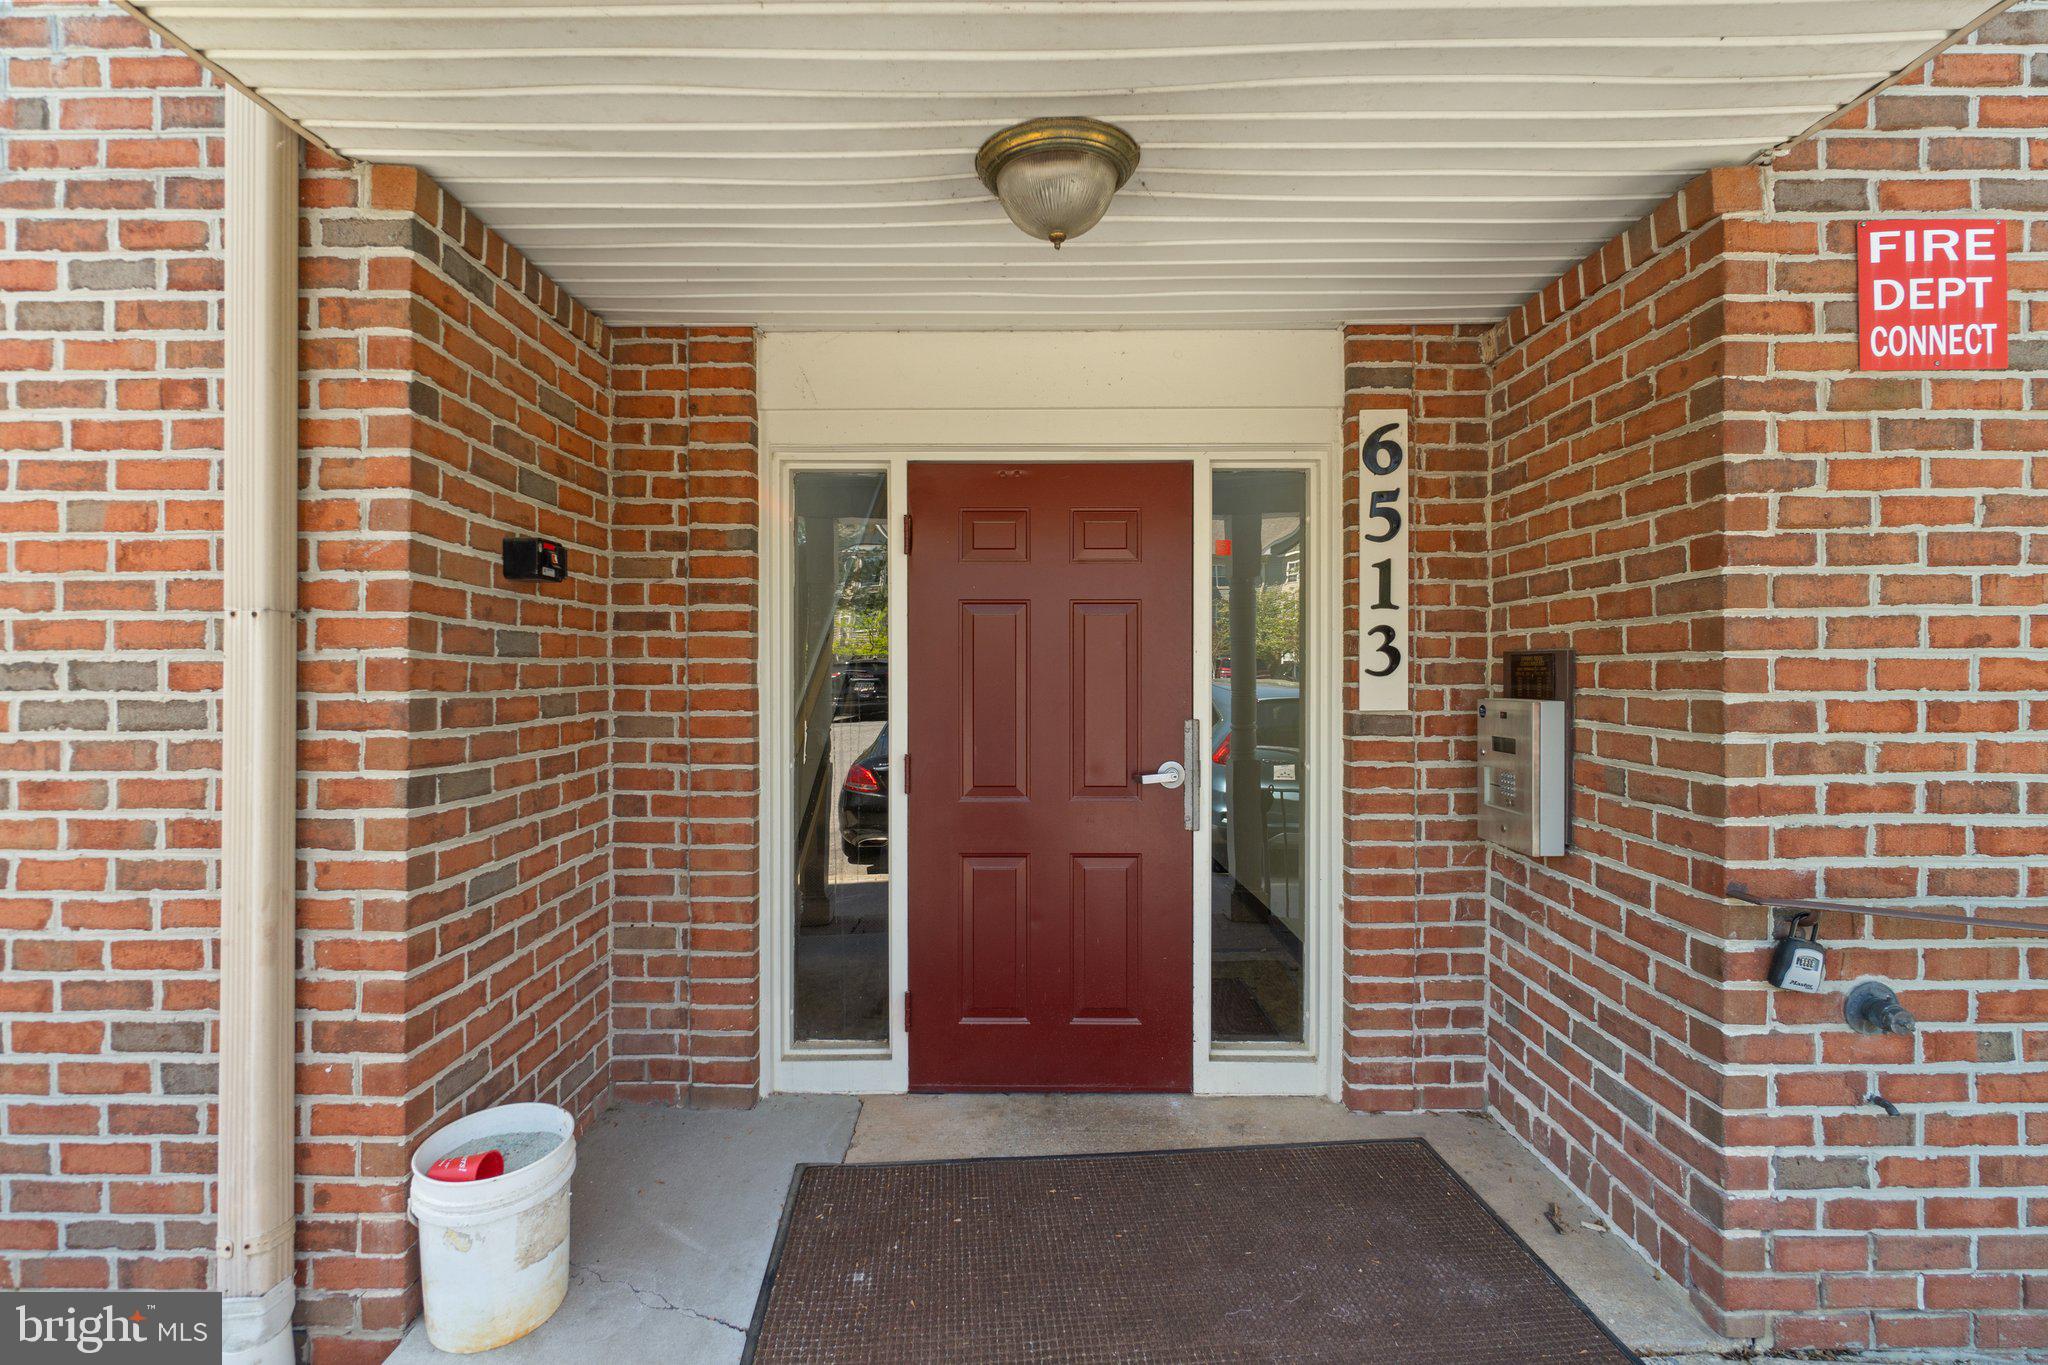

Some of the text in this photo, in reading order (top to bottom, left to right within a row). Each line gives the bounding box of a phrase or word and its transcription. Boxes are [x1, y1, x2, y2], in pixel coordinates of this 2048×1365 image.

[1870, 229, 1996, 263] FIRE
[1873, 276, 1993, 311] DEPT
[1870, 323, 1997, 357] CONNECT
[1362, 422, 1403, 677] 6513
